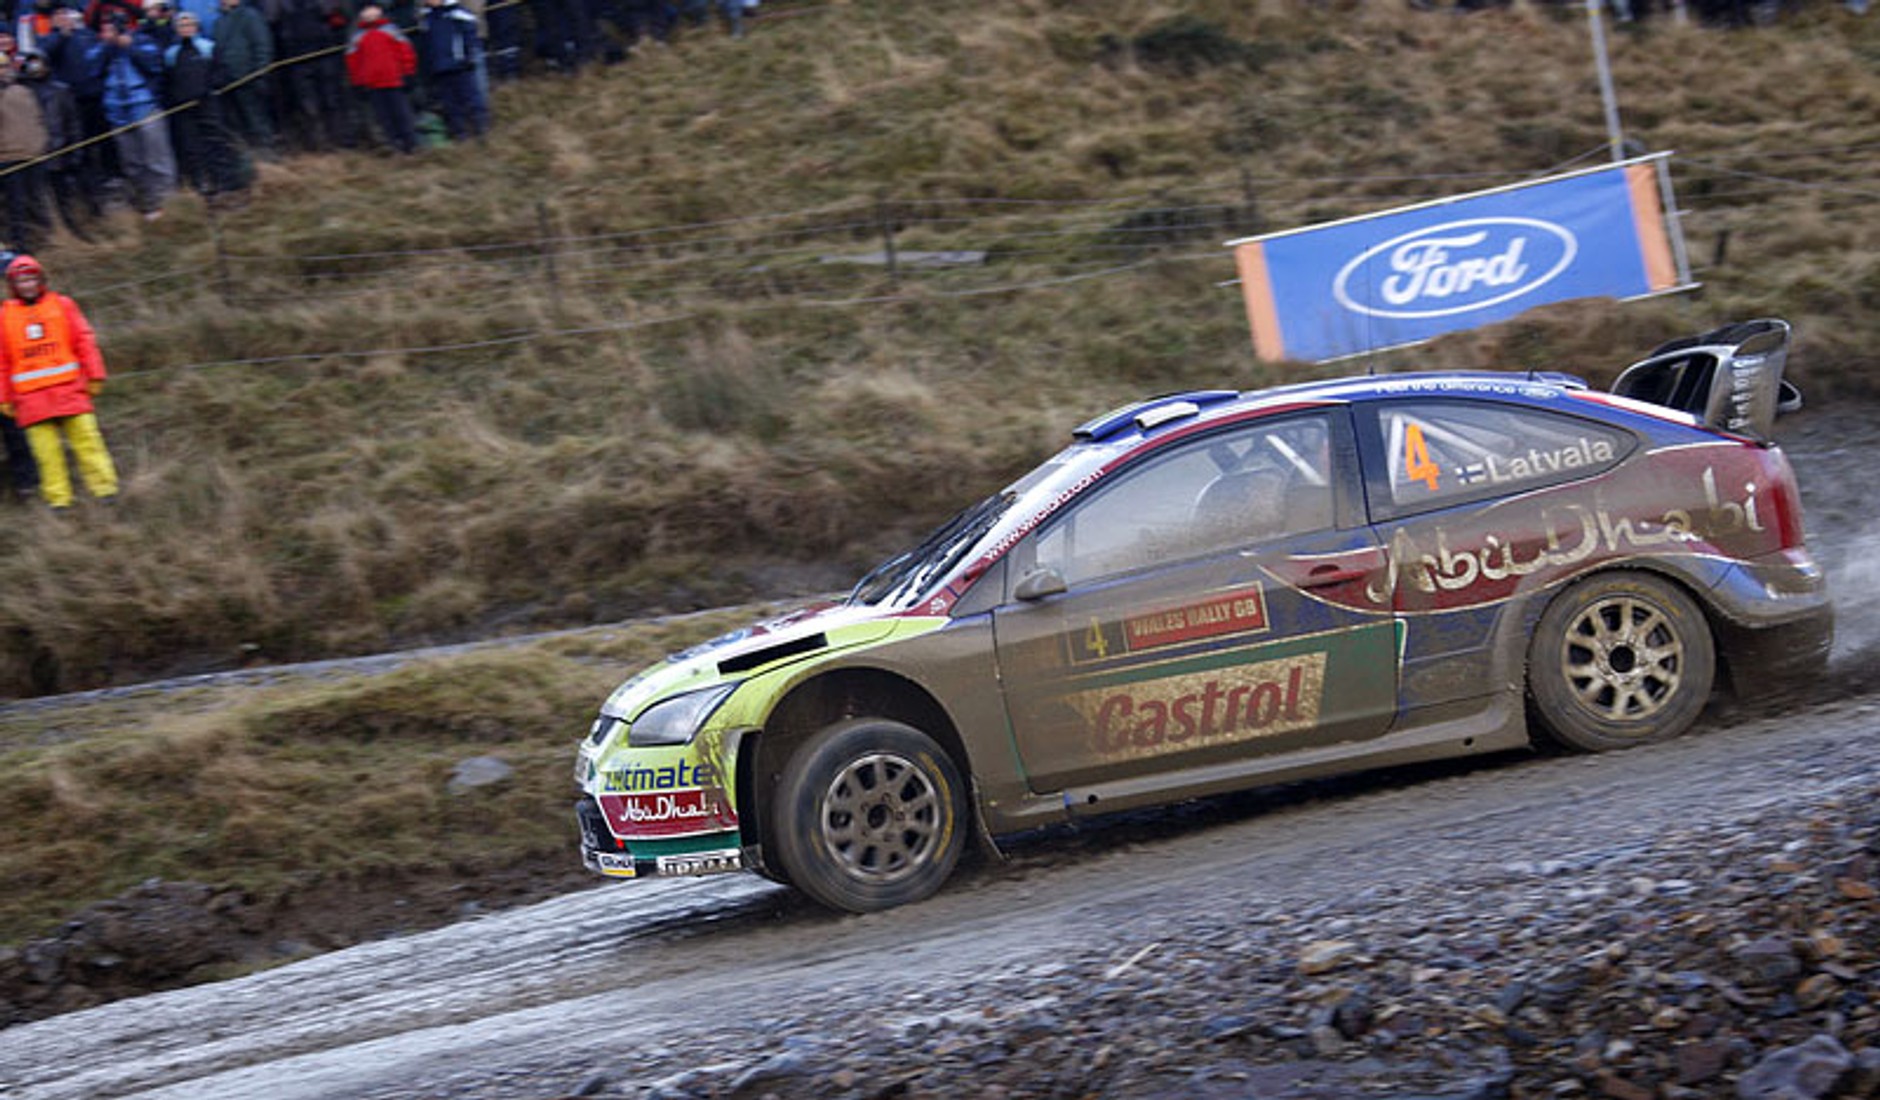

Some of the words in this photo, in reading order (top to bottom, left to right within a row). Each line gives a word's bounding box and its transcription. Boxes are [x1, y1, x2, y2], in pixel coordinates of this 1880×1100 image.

[1382, 231, 1528, 304] Ford
[1405, 424, 1440, 490] 4
[1485, 437, 1614, 483] Latvala
[1086, 616, 1108, 658] 4
[1132, 611, 1186, 637] WALES
[1187, 602, 1232, 627] RALLY
[1233, 599, 1257, 619] GB
[1096, 665, 1305, 753] Castrol
